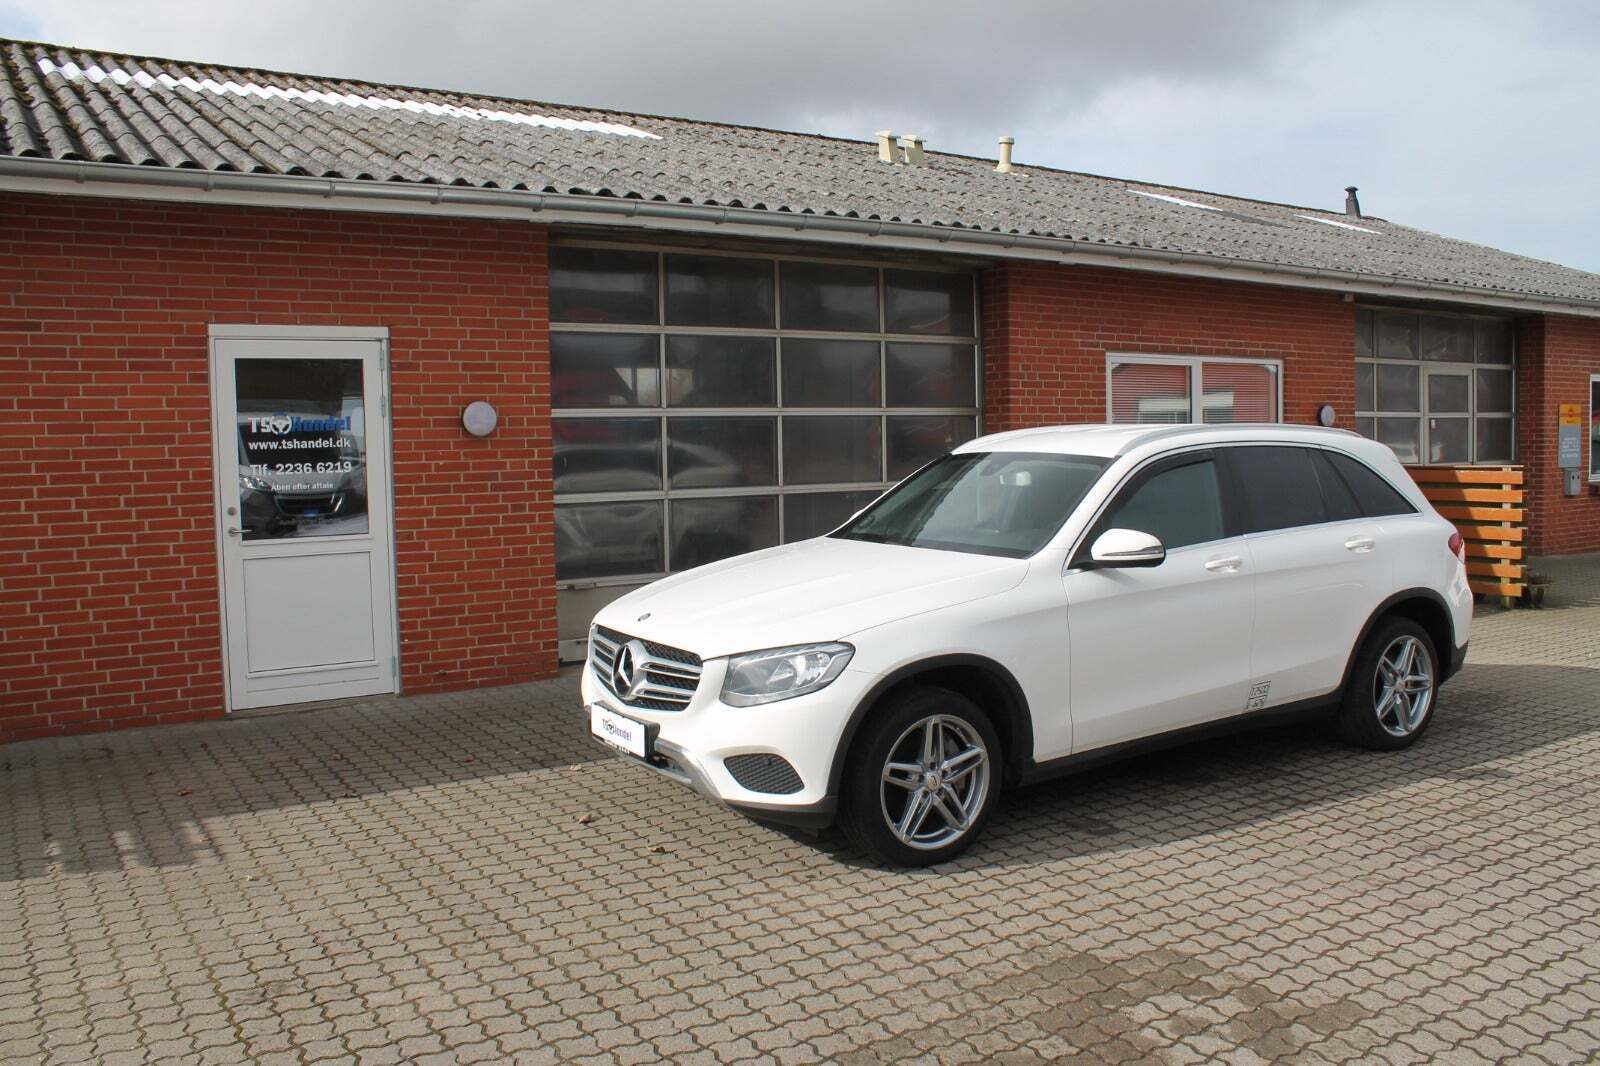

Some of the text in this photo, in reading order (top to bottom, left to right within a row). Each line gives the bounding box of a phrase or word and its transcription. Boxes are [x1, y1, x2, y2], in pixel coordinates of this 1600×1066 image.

[248, 437, 352, 451] www.tshandel.dk
[249, 460, 352, 477] Tlf. 2236 6219
